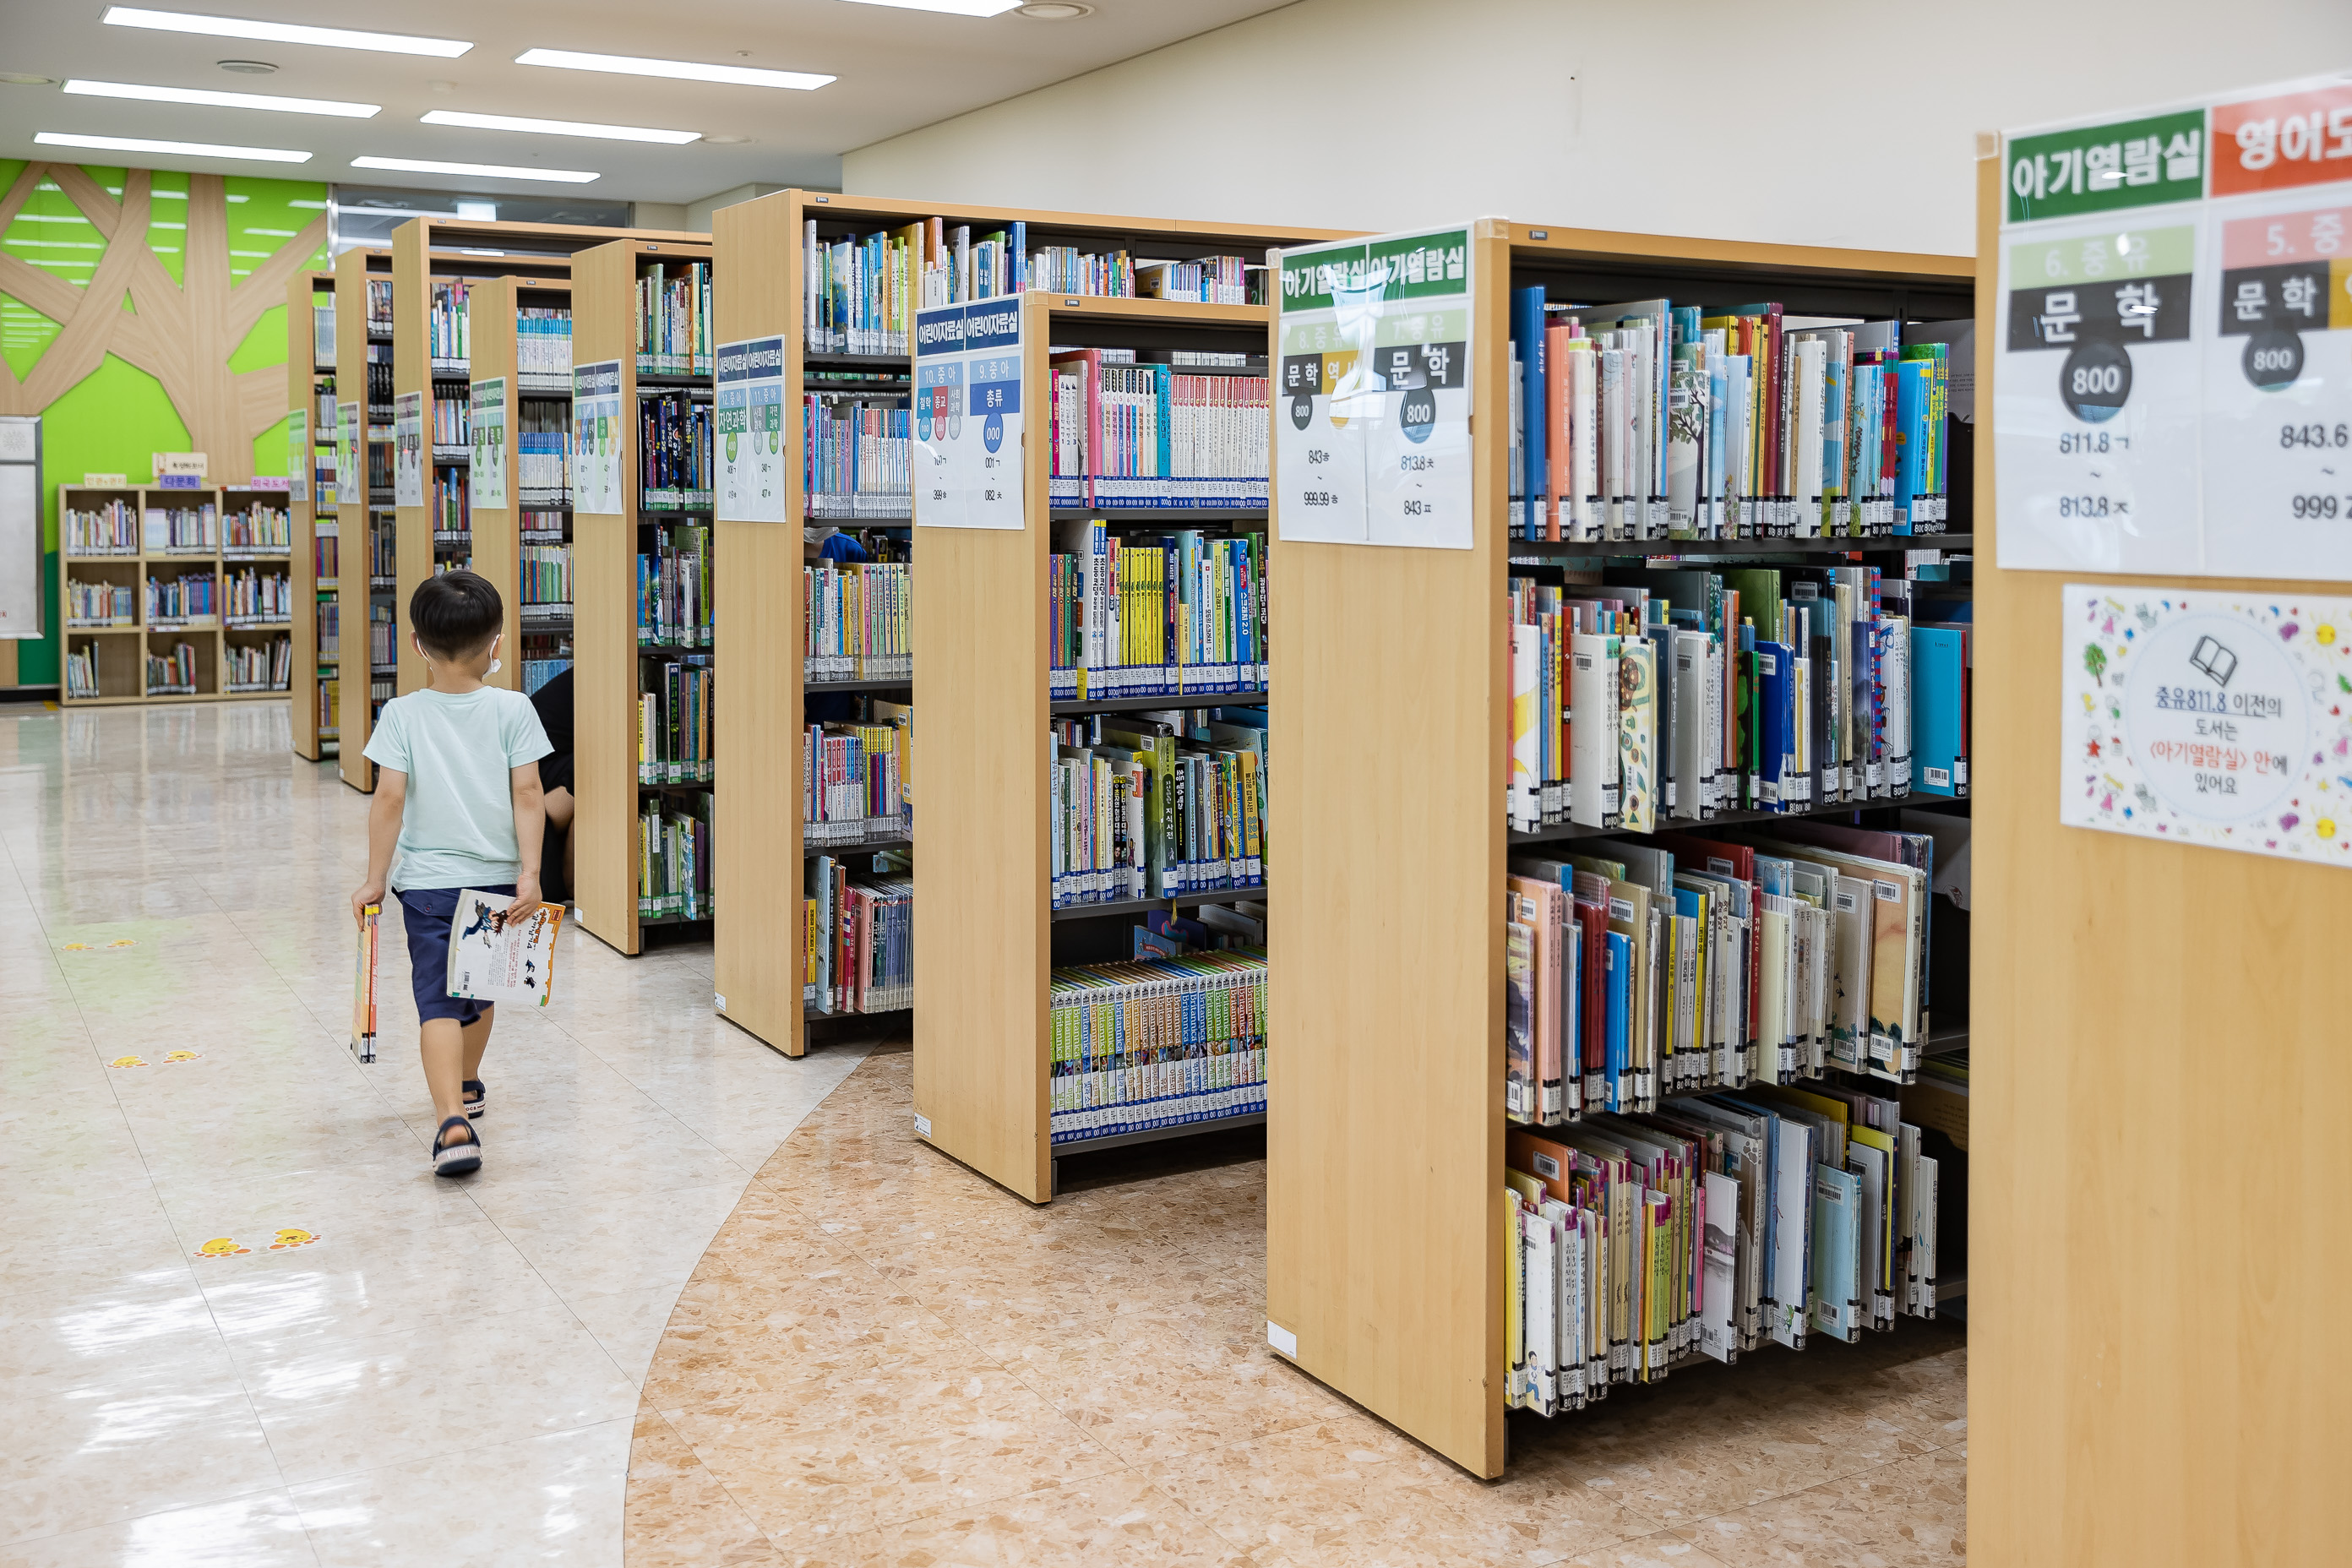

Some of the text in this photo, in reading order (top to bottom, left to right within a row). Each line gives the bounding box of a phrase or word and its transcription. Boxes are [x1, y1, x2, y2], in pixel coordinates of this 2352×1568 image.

[2012, 128, 2202, 201] 아기열람실
[2267, 224, 2295, 256] 5.
[1370, 246, 1464, 284] 아기열람실
[2045, 248, 2070, 278] 6.
[1284, 259, 1364, 297] 아기열람실
[2233, 276, 2319, 321] 문 학
[966, 311, 1018, 338] 어린이자료실
[2044, 291, 2082, 343] 문
[918, 318, 964, 345] 어린이자료실
[719, 354, 747, 373] 어린이자료실
[749, 349, 781, 369] 어린이자료실
[2253, 350, 2292, 371] 800
[2072, 368, 2120, 395] 800
[934, 395, 946, 409] 종교
[986, 389, 1004, 408] 총류
[719, 409, 746, 431] 자연과학
[1295, 406, 1309, 417] 800
[1407, 405, 1430, 422] 800
[986, 427, 1000, 441] 000
[2280, 424, 2348, 449] 843.6
[2291, 495, 2337, 520] 999
[1240, 591, 1249, 621] 스크래치
[2156, 686, 2281, 717] 중유811.8 이전의
[2195, 719, 2238, 741] 도서는
[2254, 754, 2288, 775] 안에
[2195, 774, 2238, 795] 있어요
[1247, 816, 1258, 841] 321
